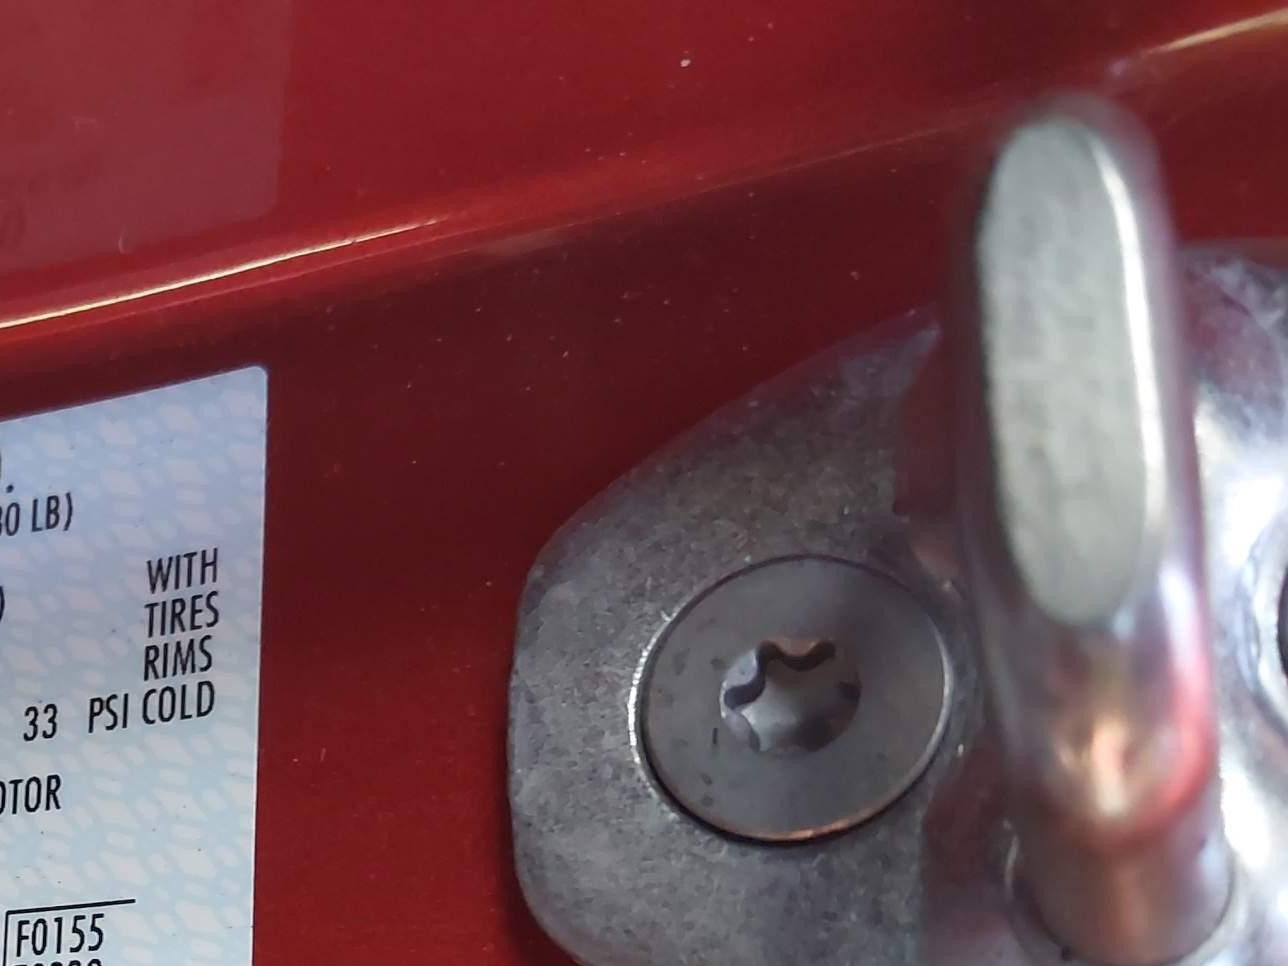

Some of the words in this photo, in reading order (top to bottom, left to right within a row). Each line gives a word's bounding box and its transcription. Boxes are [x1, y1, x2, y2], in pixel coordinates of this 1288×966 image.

[30, 492, 75, 532] LB)
[146, 548, 219, 594] WITH
[144, 590, 220, 638] TIRES
[144, 634, 213, 681] RIMS
[23, 704, 59, 742] 33
[89, 693, 129, 734] PSI
[141, 680, 216, 726] COLD
[14, 913, 106, 958] F0155
